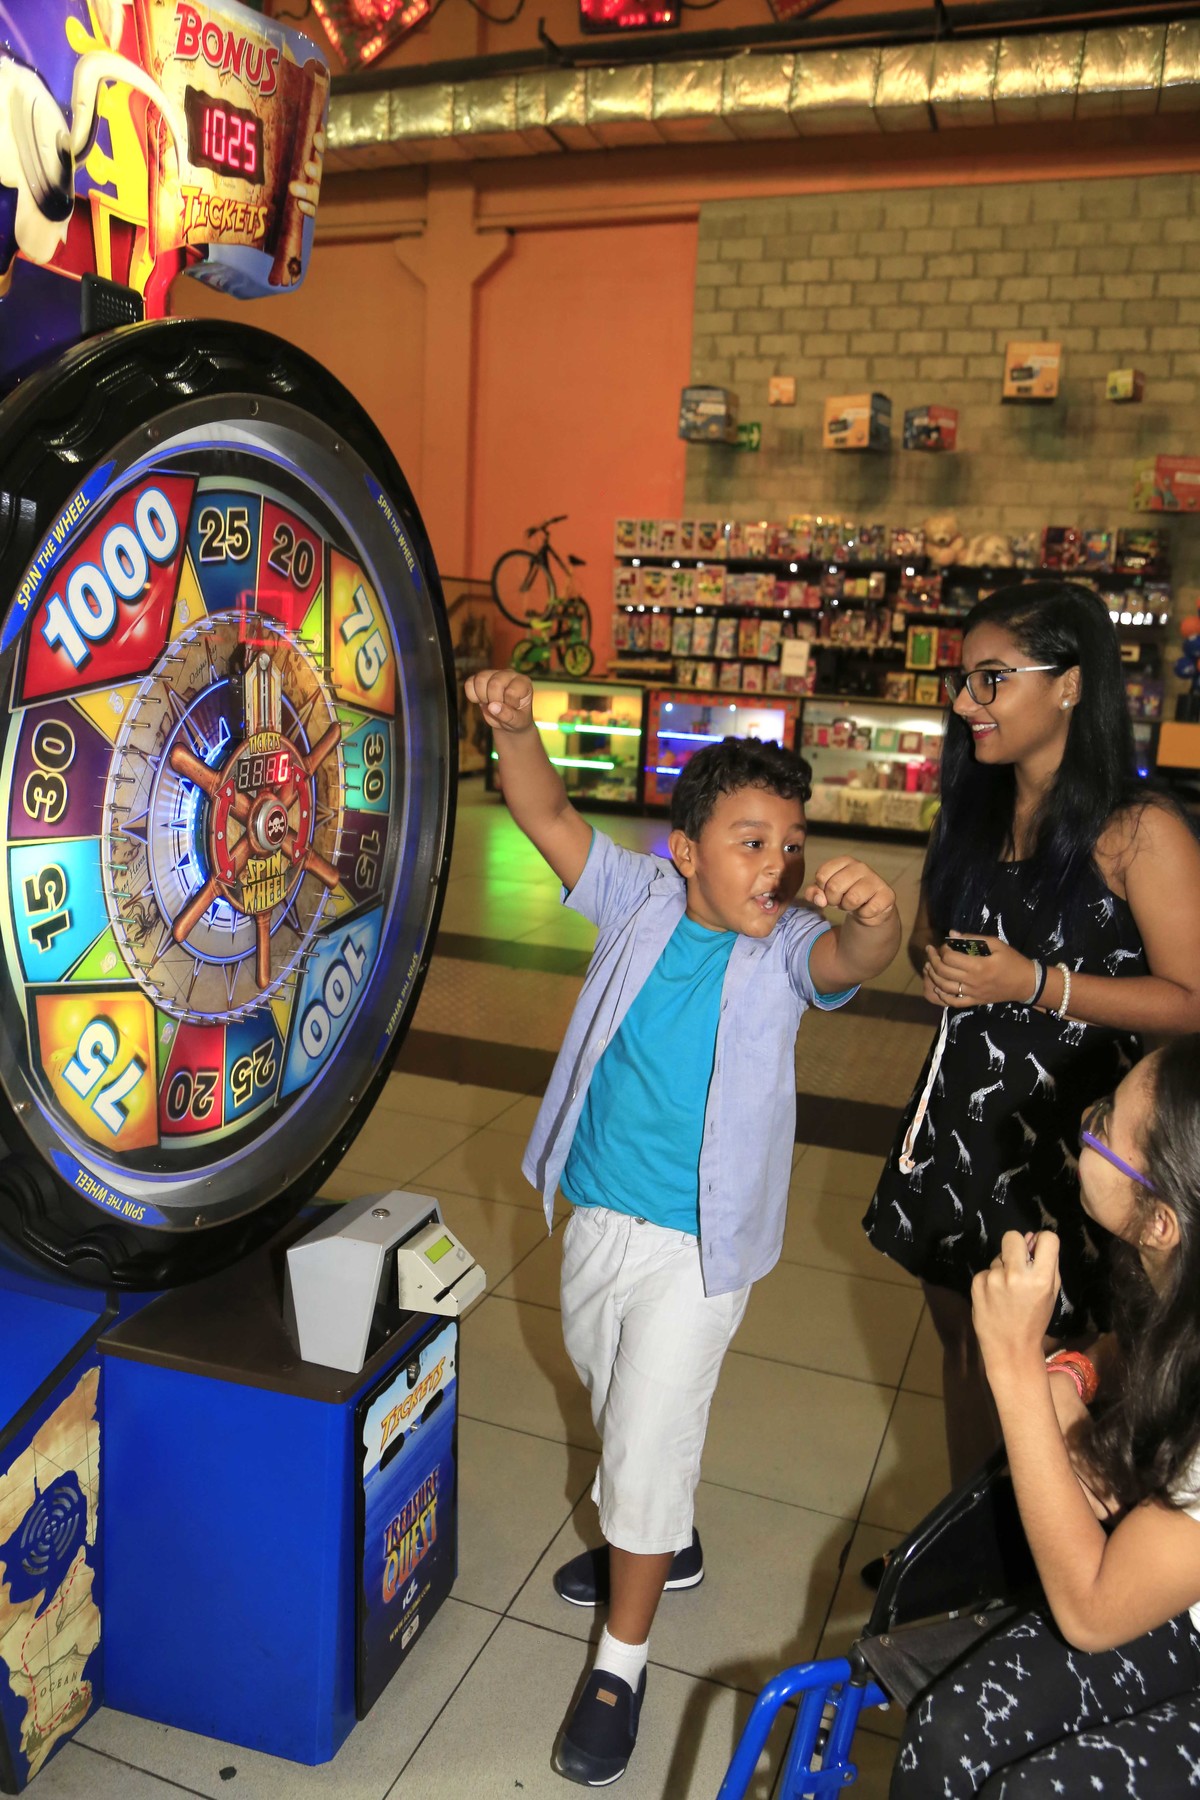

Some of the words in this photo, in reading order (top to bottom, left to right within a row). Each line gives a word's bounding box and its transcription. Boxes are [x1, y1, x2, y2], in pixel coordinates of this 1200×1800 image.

[174, 2, 279, 96] BONUS
[204, 108, 256, 172] 1025
[181, 185, 268, 239] TICKETS
[17, 565, 42, 611] SPIN
[37, 539, 57, 569] THE
[52, 491, 90, 544] WHEEL
[198, 507, 252, 561] 25
[268, 523, 315, 588] 20
[377, 494, 393, 520] SPIN
[391, 517, 401, 536] THE
[398, 533, 415, 573] WHEEL
[40, 486, 179, 669] 1000
[339, 585, 388, 689] 75
[22, 719, 76, 823] 30
[249, 732, 281, 755] TICKETS
[364, 733, 386, 803] 30
[247, 849, 282, 883] SPIN
[355, 830, 381, 889] 15
[22, 863, 69, 954] 15
[242, 874, 287, 914] WHEEL
[301, 934, 367, 1059] 100
[61, 1019, 146, 1137] 75
[166, 1070, 219, 1121] 20
[230, 1039, 276, 1107] 25
[75, 1169, 108, 1203] WHEEL
[106, 1194, 123, 1210] THE
[121, 1201, 146, 1220] SPIN
[380, 1356, 446, 1452] TICKETS
[384, 1464, 440, 1559] TREASURE
[383, 1499, 438, 1603] QUEST
[402, 1578, 418, 1610] ICE
[40, 1672, 78, 1697] OCEAN
